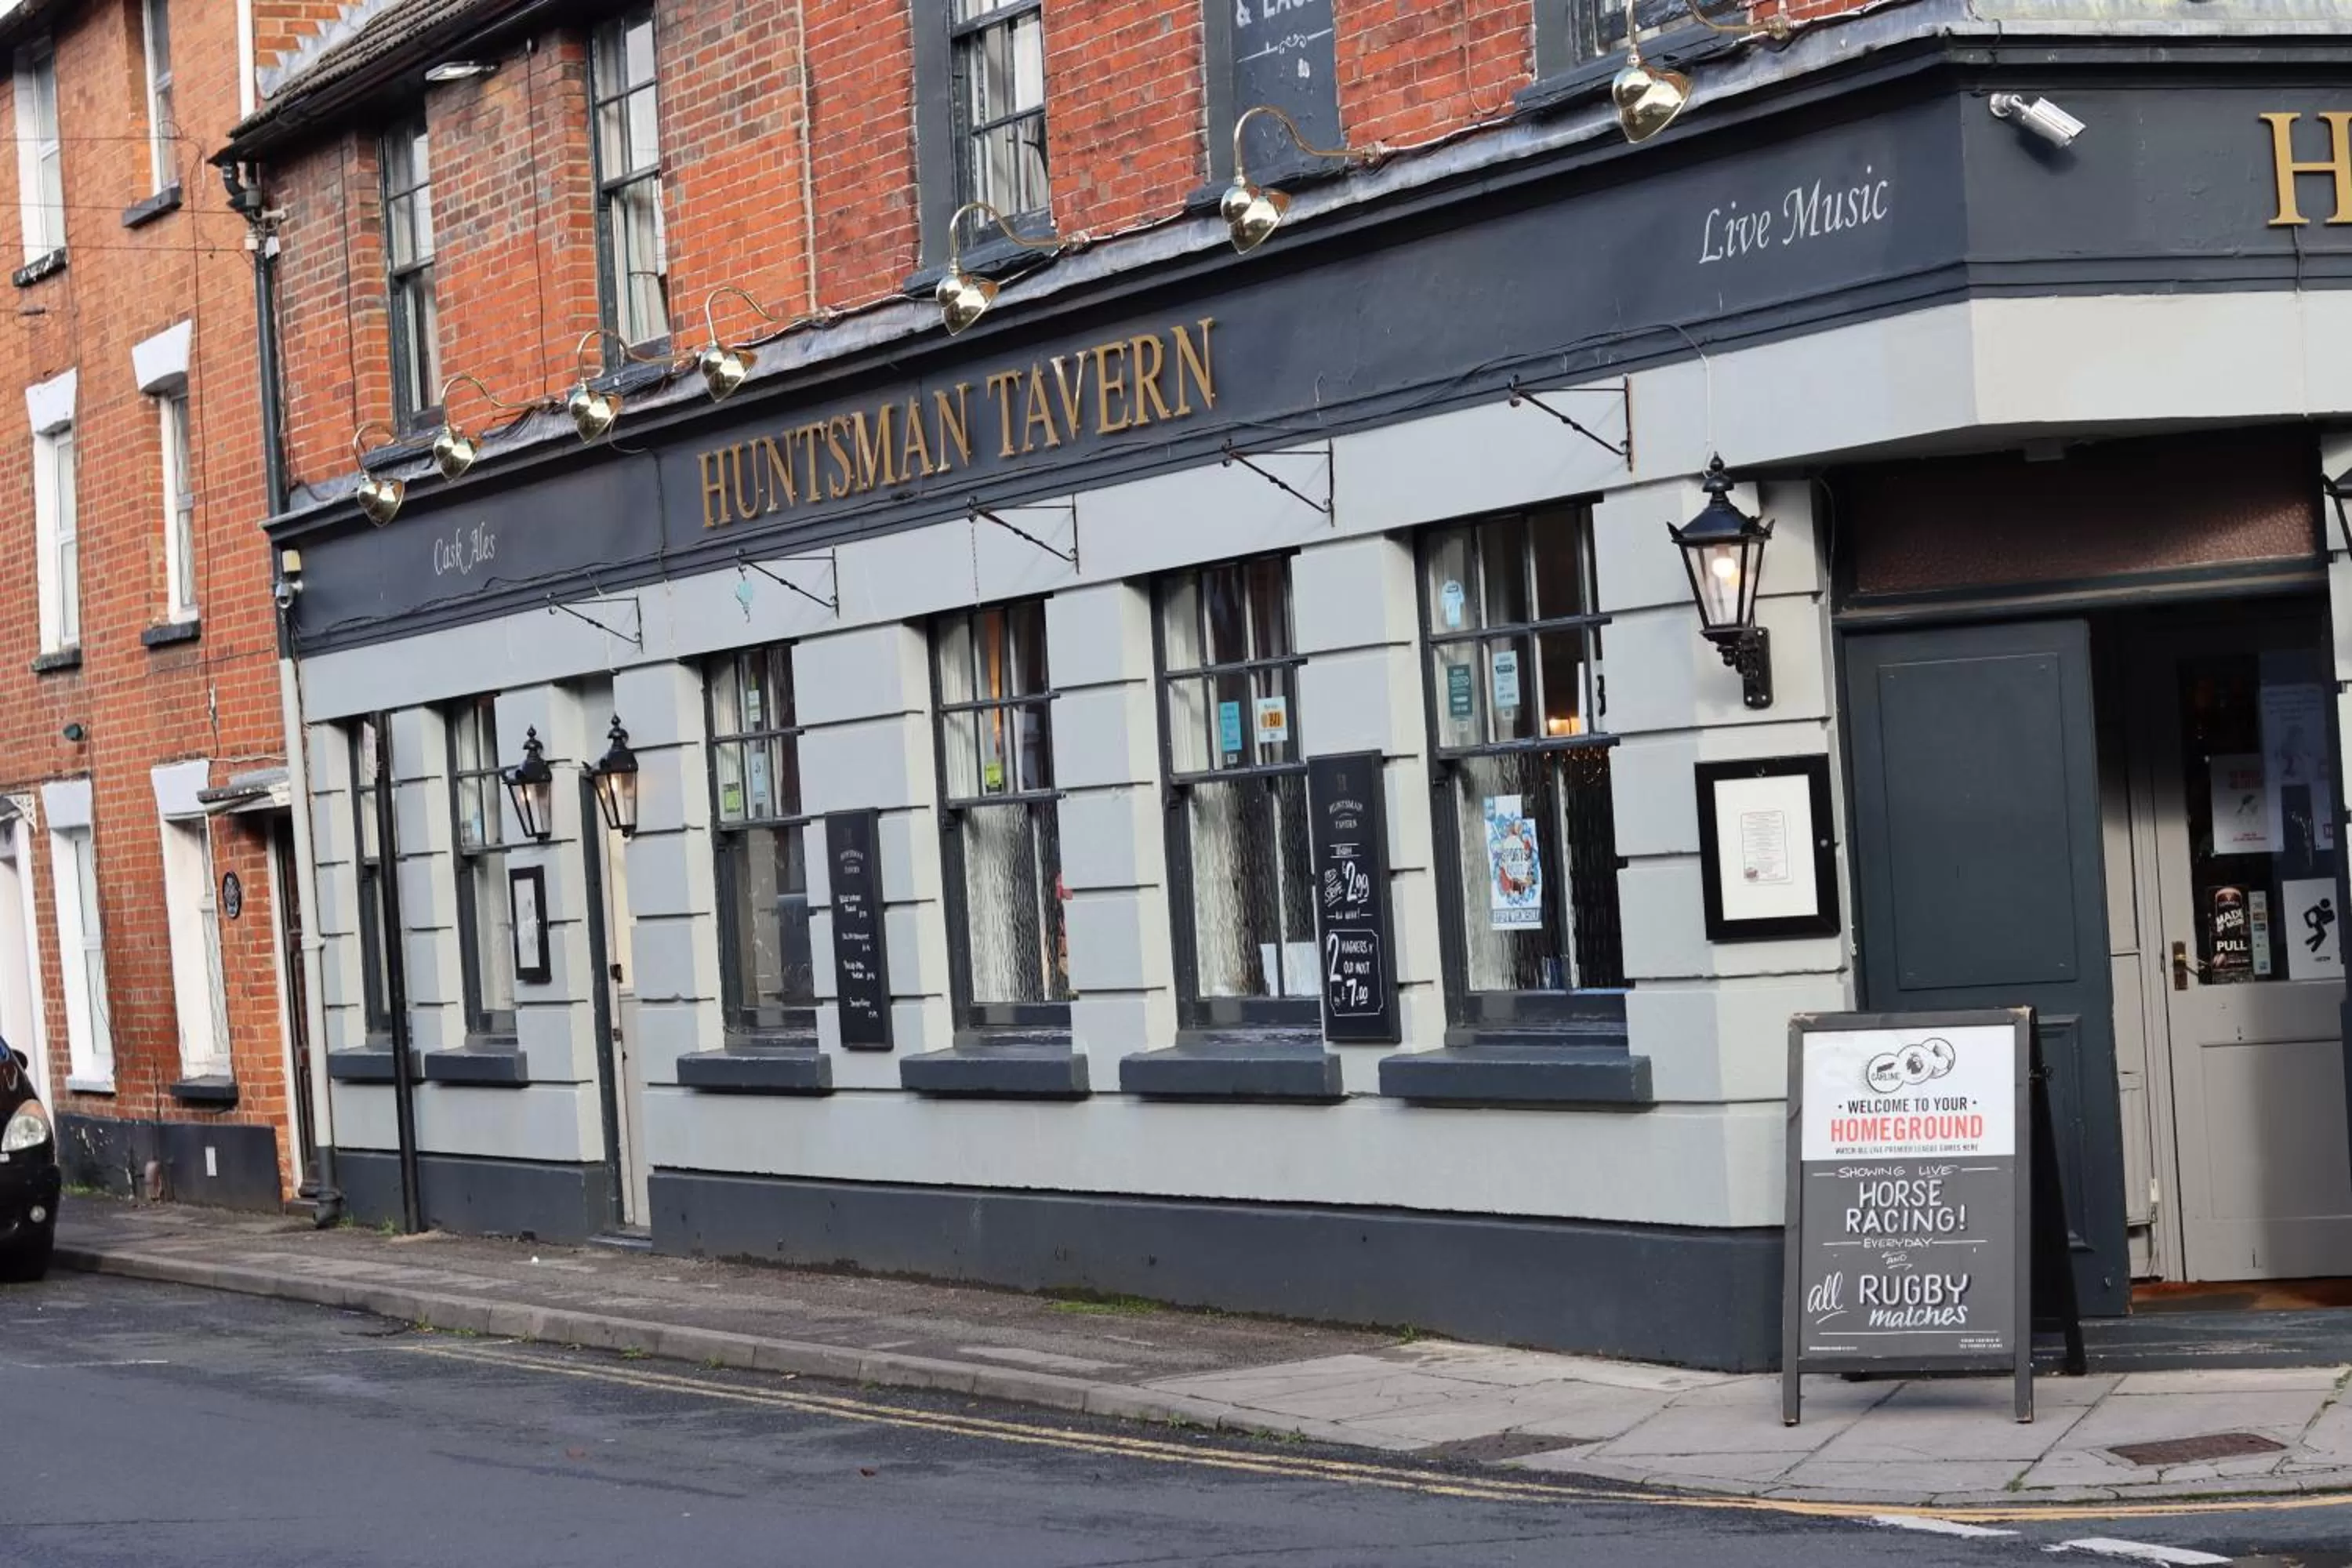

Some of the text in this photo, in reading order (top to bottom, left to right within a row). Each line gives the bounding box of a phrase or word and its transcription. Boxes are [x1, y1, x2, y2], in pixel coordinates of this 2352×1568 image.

[1699, 165, 1888, 264] Live Music
[697, 318, 1216, 528] HUNTSMAN TAVERN
[434, 521, 495, 575] Cask Ales
[1328, 933, 1341, 982] 2
[2216, 940, 2248, 952] PULL
[1848, 1097, 1968, 1113] WELCOME TO YOUR
[1831, 1115, 1983, 1142] HOMEGROUND
[1838, 1164, 1959, 1178] SHOWING LIVE
[1859, 1179, 1943, 1208] HORSE
[1846, 1204, 1967, 1234] RACING!
[1863, 1237, 1933, 1249] EVERYDAY
[1886, 1254, 1907, 1265] AND
[1807, 1271, 1970, 1313] all RUGBY
[1869, 1305, 1969, 1327] matches
